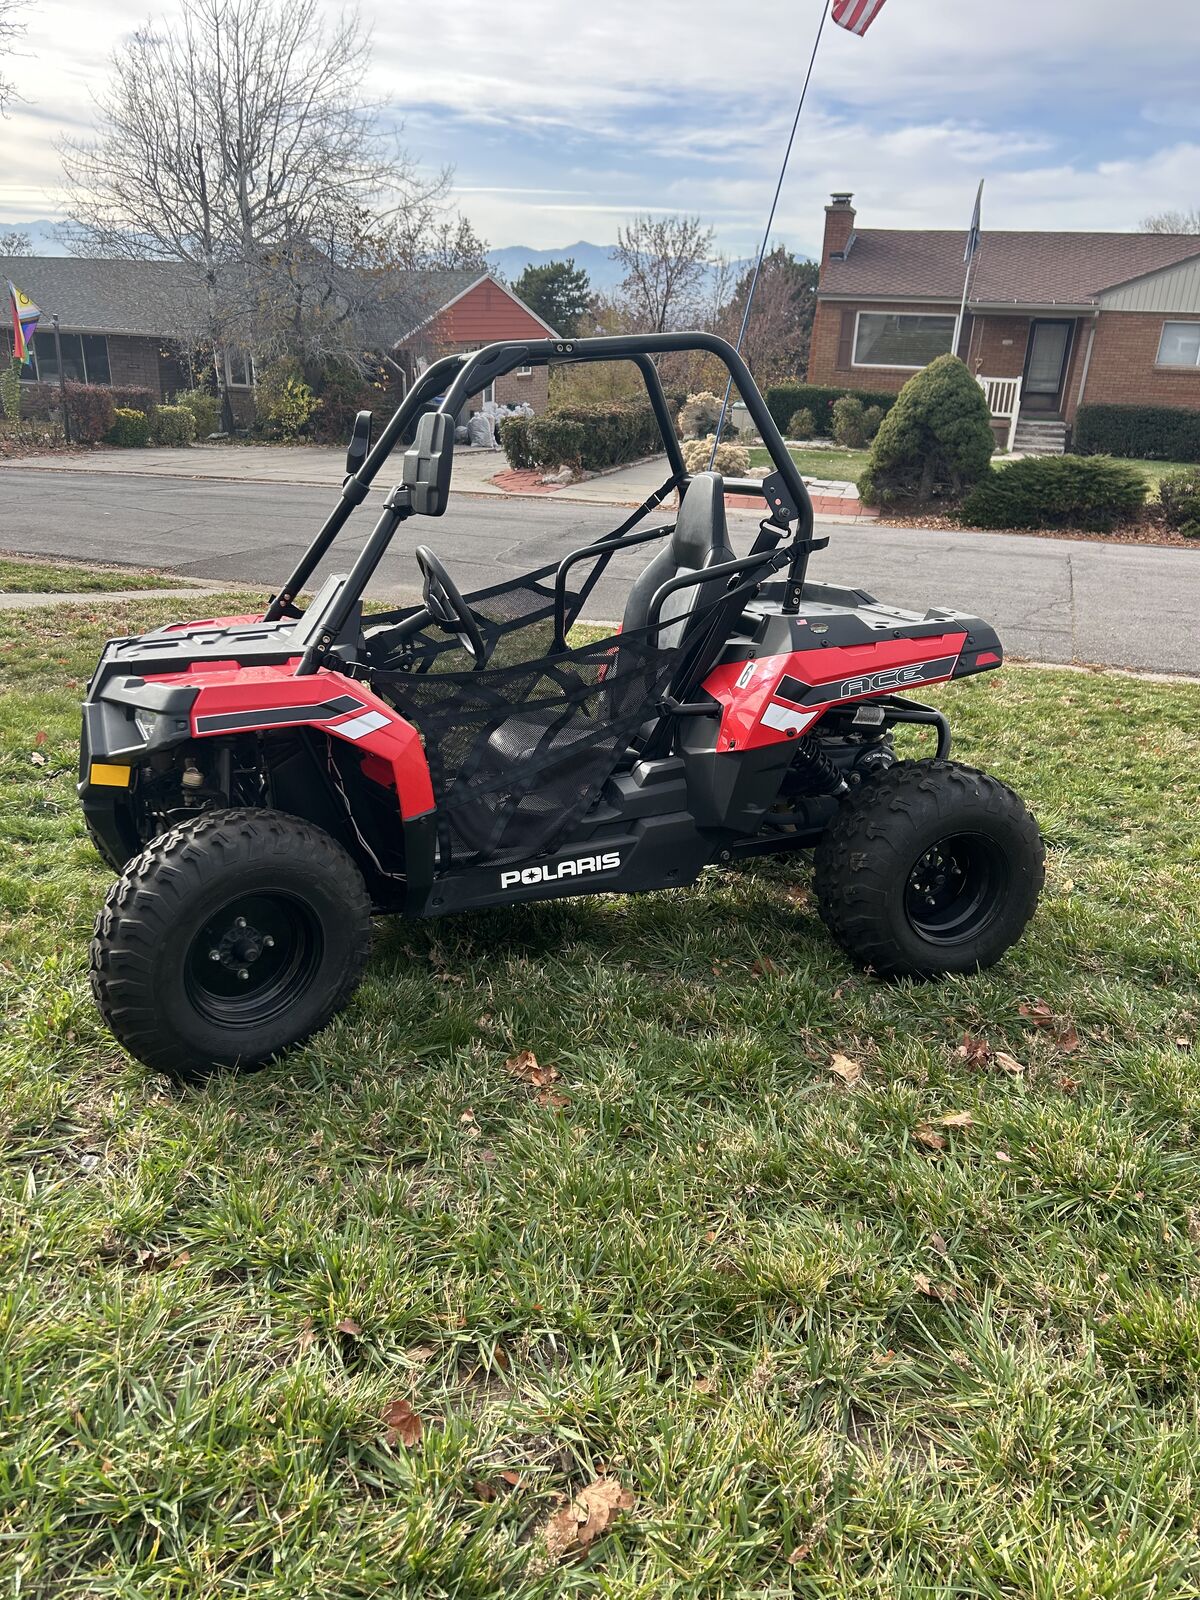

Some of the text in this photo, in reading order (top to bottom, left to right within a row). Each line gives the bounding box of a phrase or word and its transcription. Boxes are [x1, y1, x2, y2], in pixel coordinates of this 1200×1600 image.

[740, 664, 754, 686] 6
[840, 664, 924, 698] ACE
[500, 851, 621, 889] POLARIS
